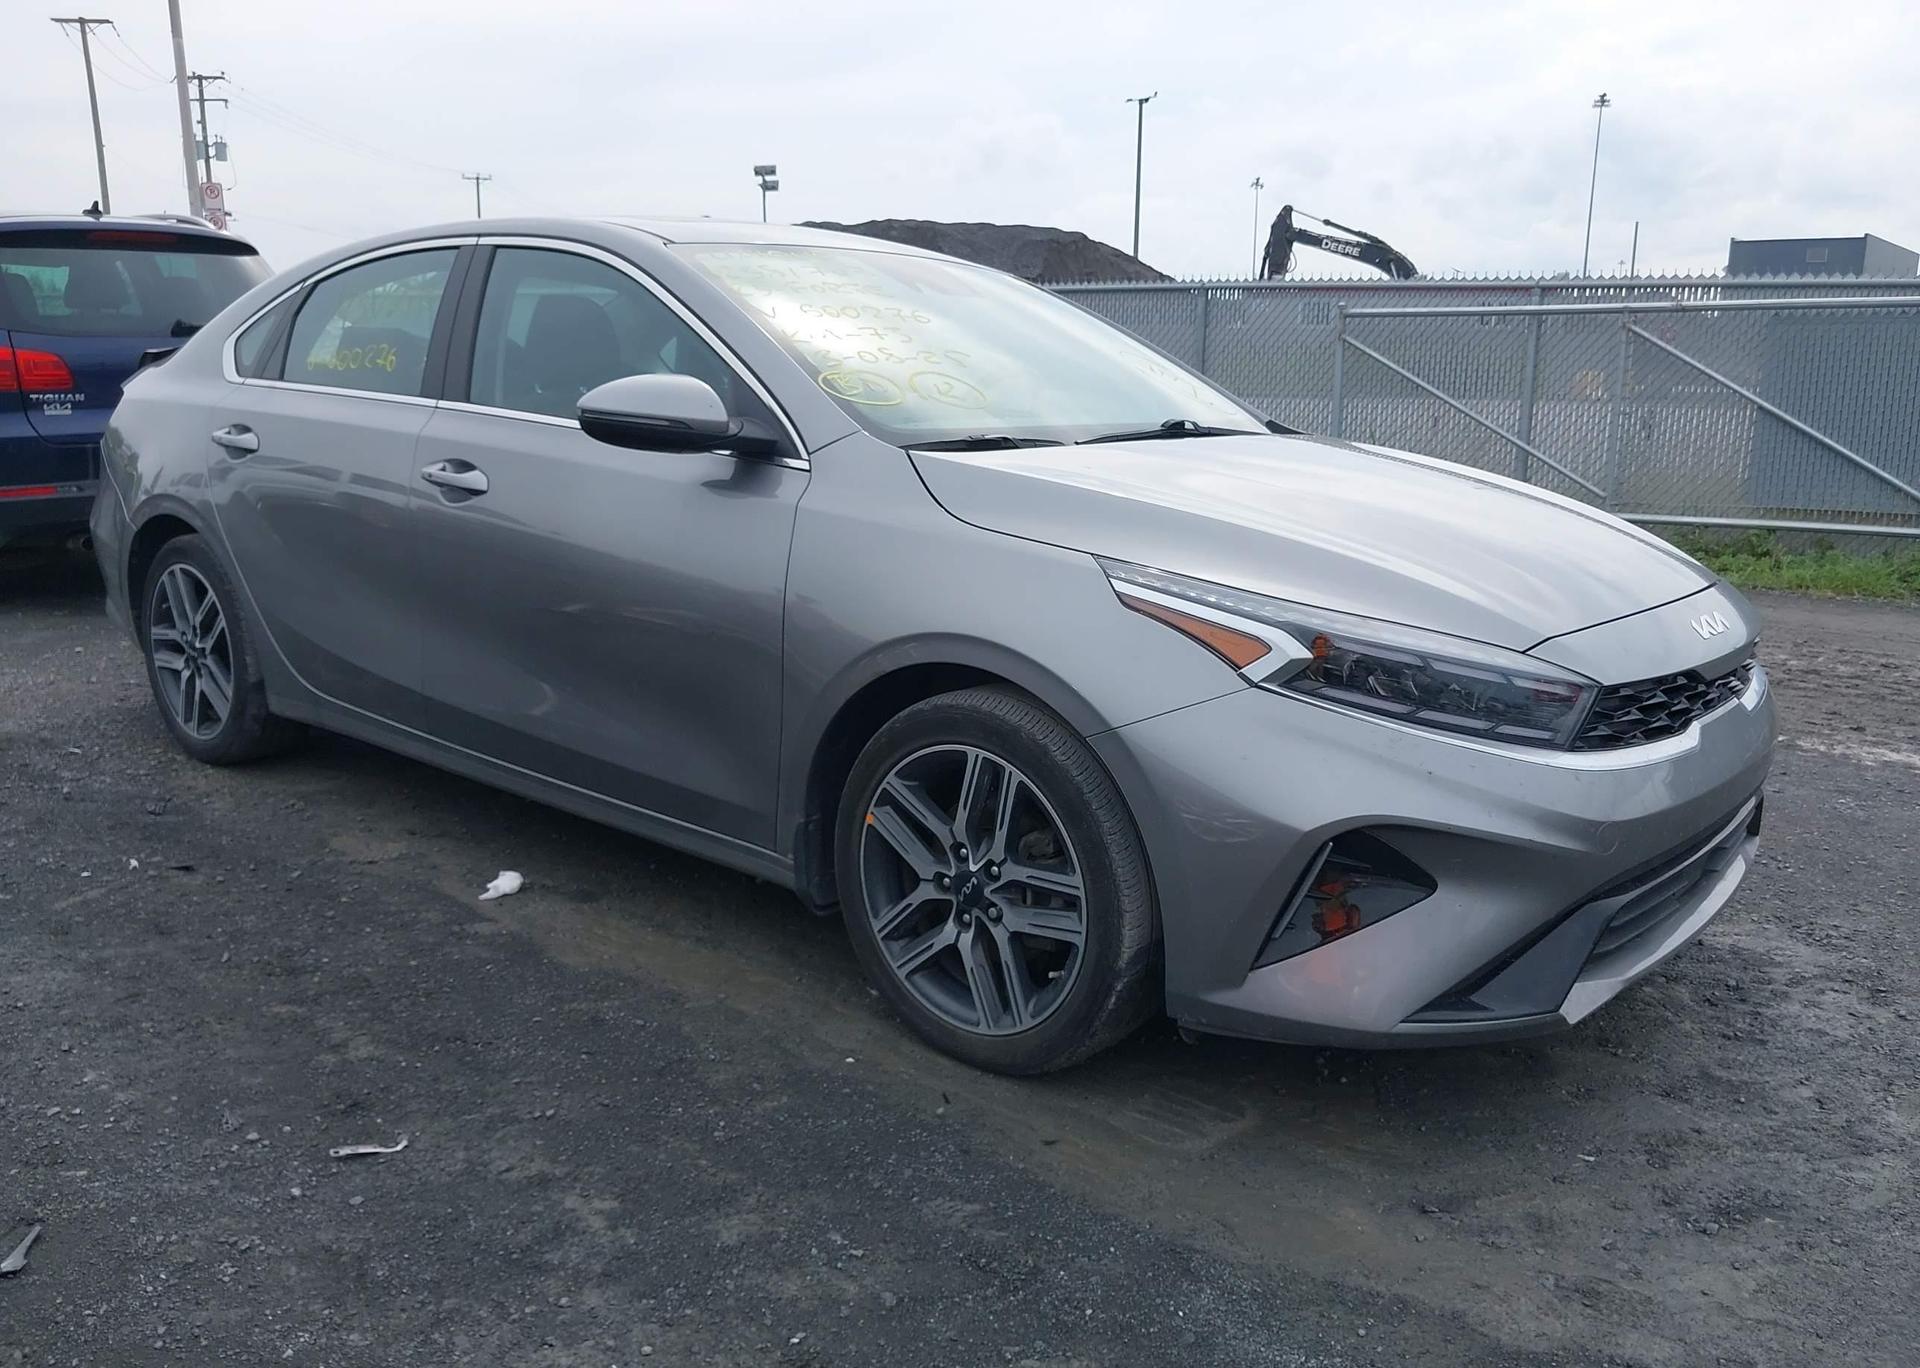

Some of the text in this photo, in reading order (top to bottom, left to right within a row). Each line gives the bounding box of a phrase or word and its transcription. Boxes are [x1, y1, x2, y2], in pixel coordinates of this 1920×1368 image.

[1321, 239, 1361, 257] DEERE
[29, 393, 85, 402] TIGUAN
[1690, 611, 1730, 641] KIA
